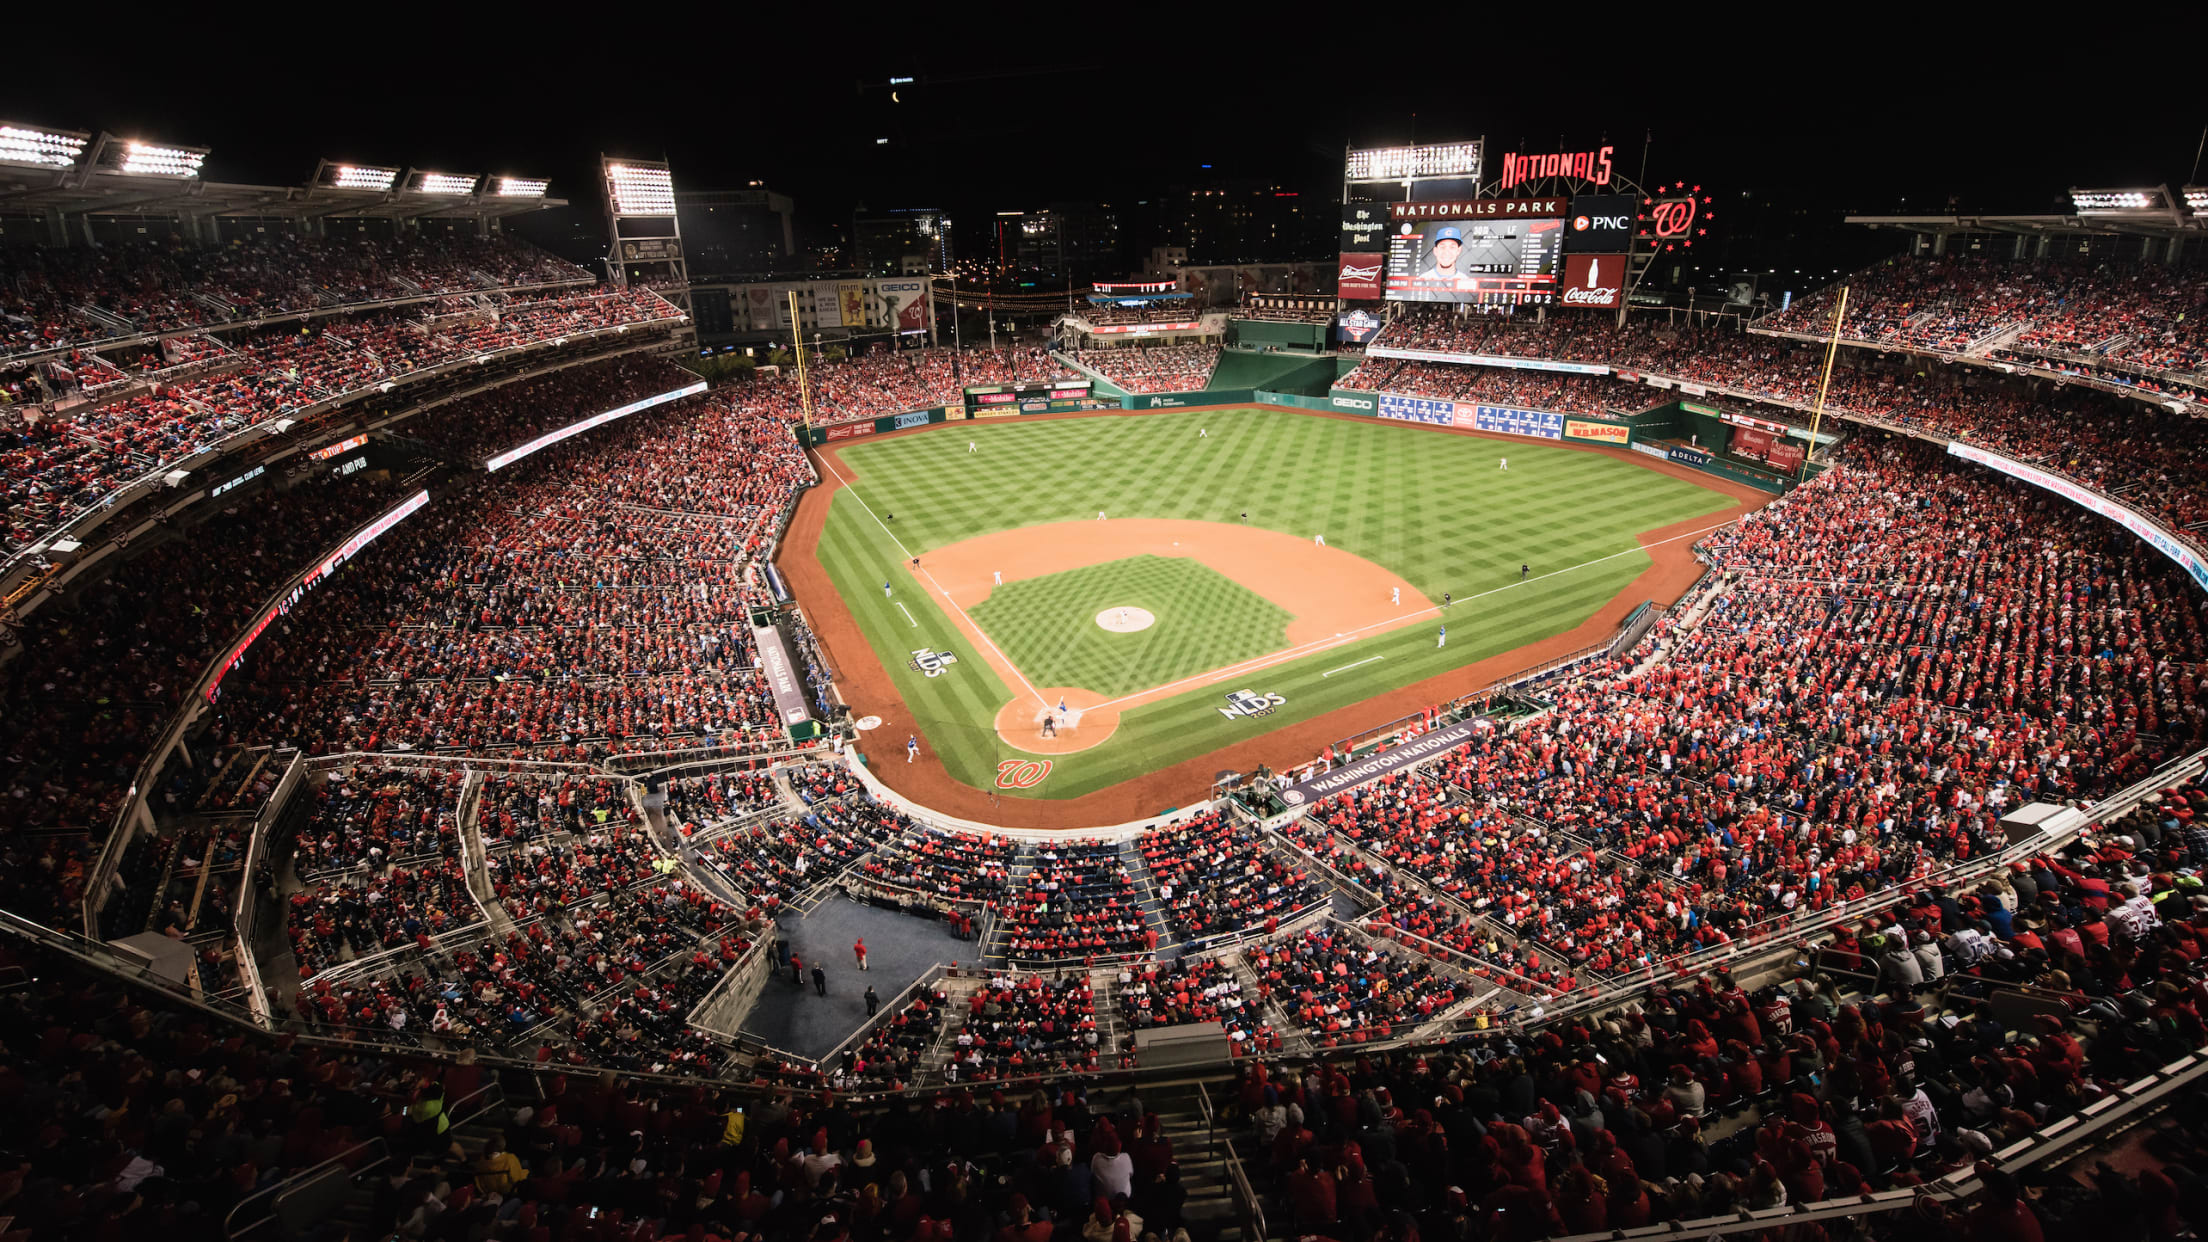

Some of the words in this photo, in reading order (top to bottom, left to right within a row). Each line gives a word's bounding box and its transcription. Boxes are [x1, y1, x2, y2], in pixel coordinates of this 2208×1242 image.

[1502, 146, 1613, 189] NATIONALS
[1356, 210, 1370, 219] The
[1396, 203, 1496, 216] NATIONALS
[1506, 202, 1556, 213] PARK
[1342, 221, 1383, 232] Washington
[1507, 225, 1517, 234] LF
[1592, 216, 1629, 230] PNC
[1353, 234, 1370, 244] Post
[881, 283, 920, 292] GEICO
[1564, 287, 1618, 305] Coca-Cola
[1333, 397, 1372, 410] GEICO
[903, 414, 928, 425] INOVA
[1573, 427, 1627, 437] W.B.MASON
[1678, 452, 1703, 464] DELTA
[342, 461, 355, 475] AND
[354, 456, 367, 471] PUB
[766, 645, 788, 678] NATIONALS
[911, 647, 948, 678] NLDS
[776, 676, 793, 695] PARK
[1216, 692, 1287, 720] NLDS
[1251, 707, 1275, 719] 2017
[1310, 751, 1404, 793] WASHINGTON
[1402, 727, 1471, 759] NATIONALS
[995, 759, 1053, 789] W
